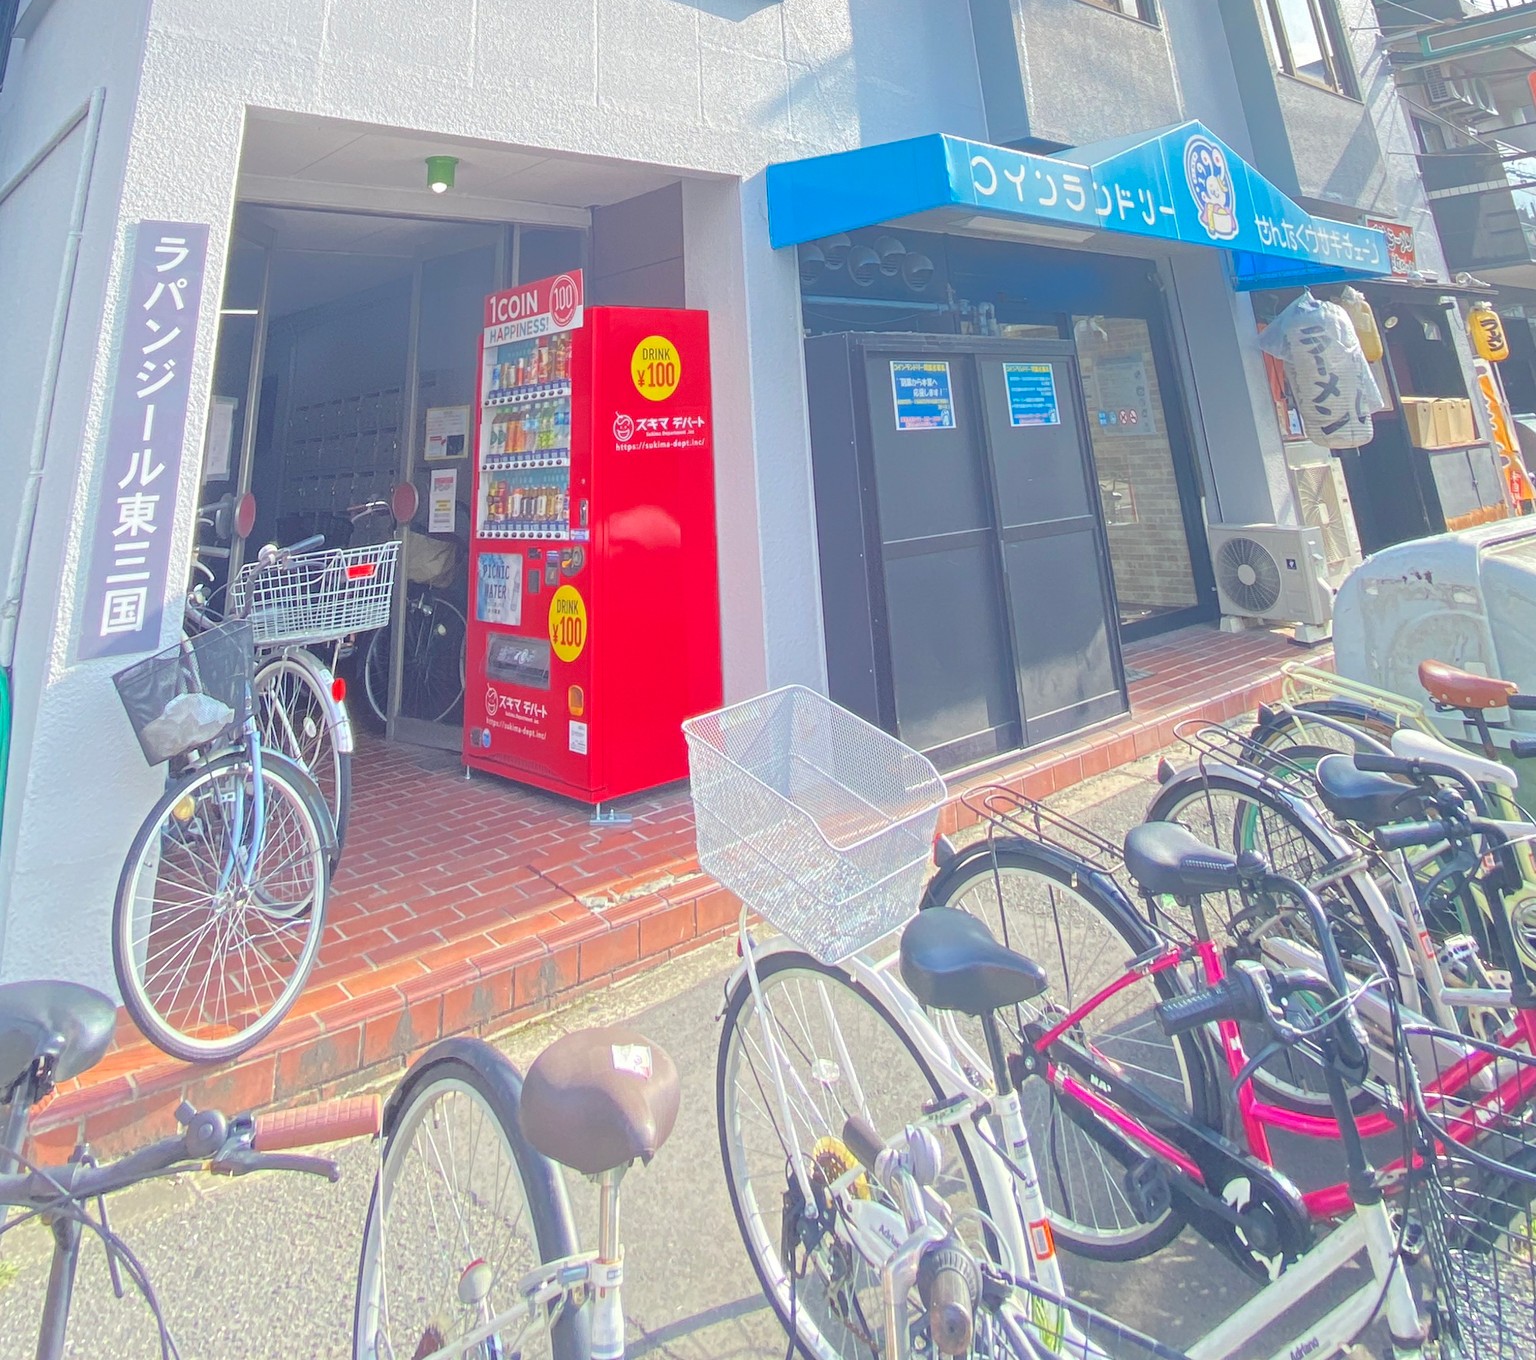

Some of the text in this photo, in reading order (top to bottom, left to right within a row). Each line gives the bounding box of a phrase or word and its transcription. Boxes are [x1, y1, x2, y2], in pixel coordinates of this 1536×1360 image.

[970, 155, 1176, 226] コインランドリー
[553, 284, 574, 312] 100
[489, 316, 550, 344] HAPPINESS!
[642, 348, 671, 361] DRINK
[637, 361, 675, 388] ¥100
[1298, 324, 1342, 436] ラーメン
[99, 236, 190, 638] ラパンジール東三国
[636, 418, 669, 431] スキマ
[556, 599, 579, 615] DRINK
[552, 616, 582, 648] ¥100
[499, 695, 522, 713] スキマ
